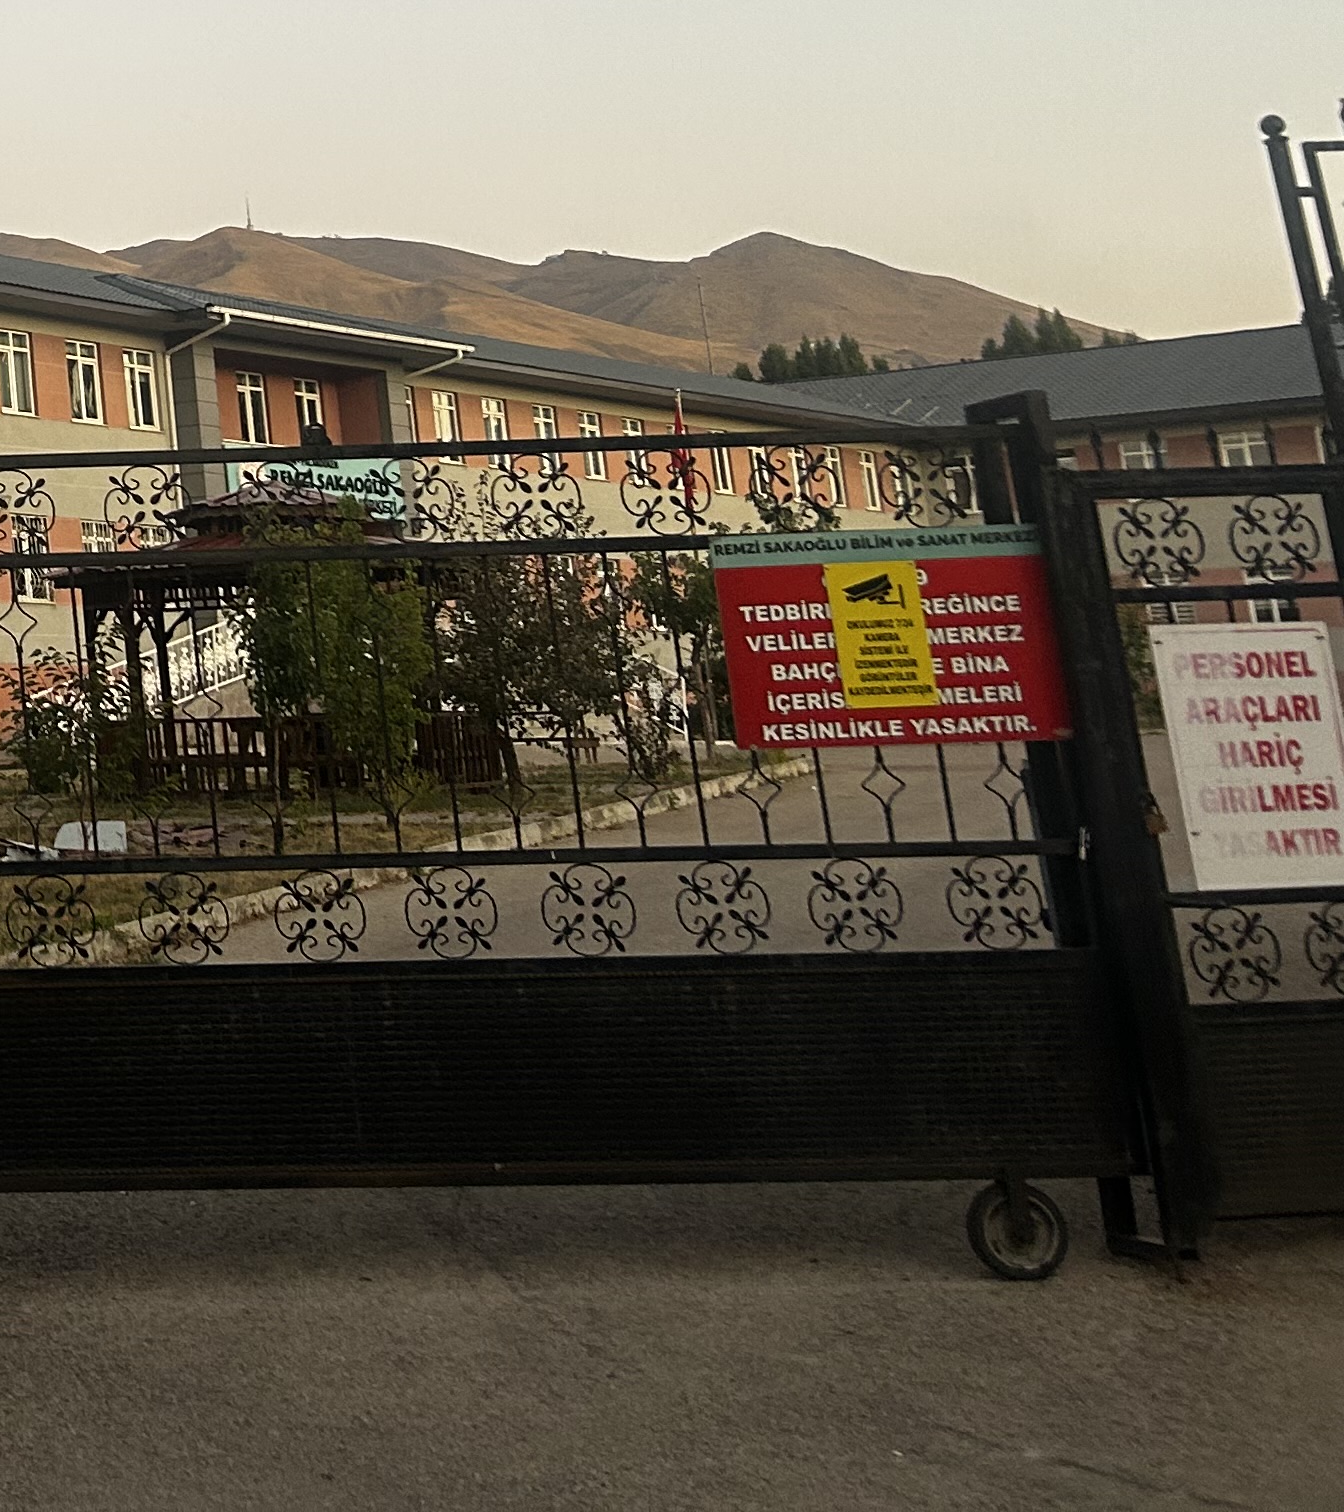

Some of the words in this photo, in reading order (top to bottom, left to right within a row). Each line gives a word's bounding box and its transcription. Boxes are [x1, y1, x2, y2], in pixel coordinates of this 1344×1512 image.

[714, 539, 760, 556] REMZİ
[764, 537, 846, 554] SAKAOĞLU
[850, 534, 892, 550] BİLİM
[918, 532, 967, 546] SANAT
[927, 624, 1025, 645] MERKEZ
[950, 652, 1010, 675] BİNA
[1174, 650, 1317, 680] PERSONEL
[1185, 694, 1321, 731] ARAÇLARI
[762, 718, 905, 741] KESİNLİKLE
[909, 714, 1037, 737] YASAKTIR.
[1218, 732, 1305, 775] HARİÇ
